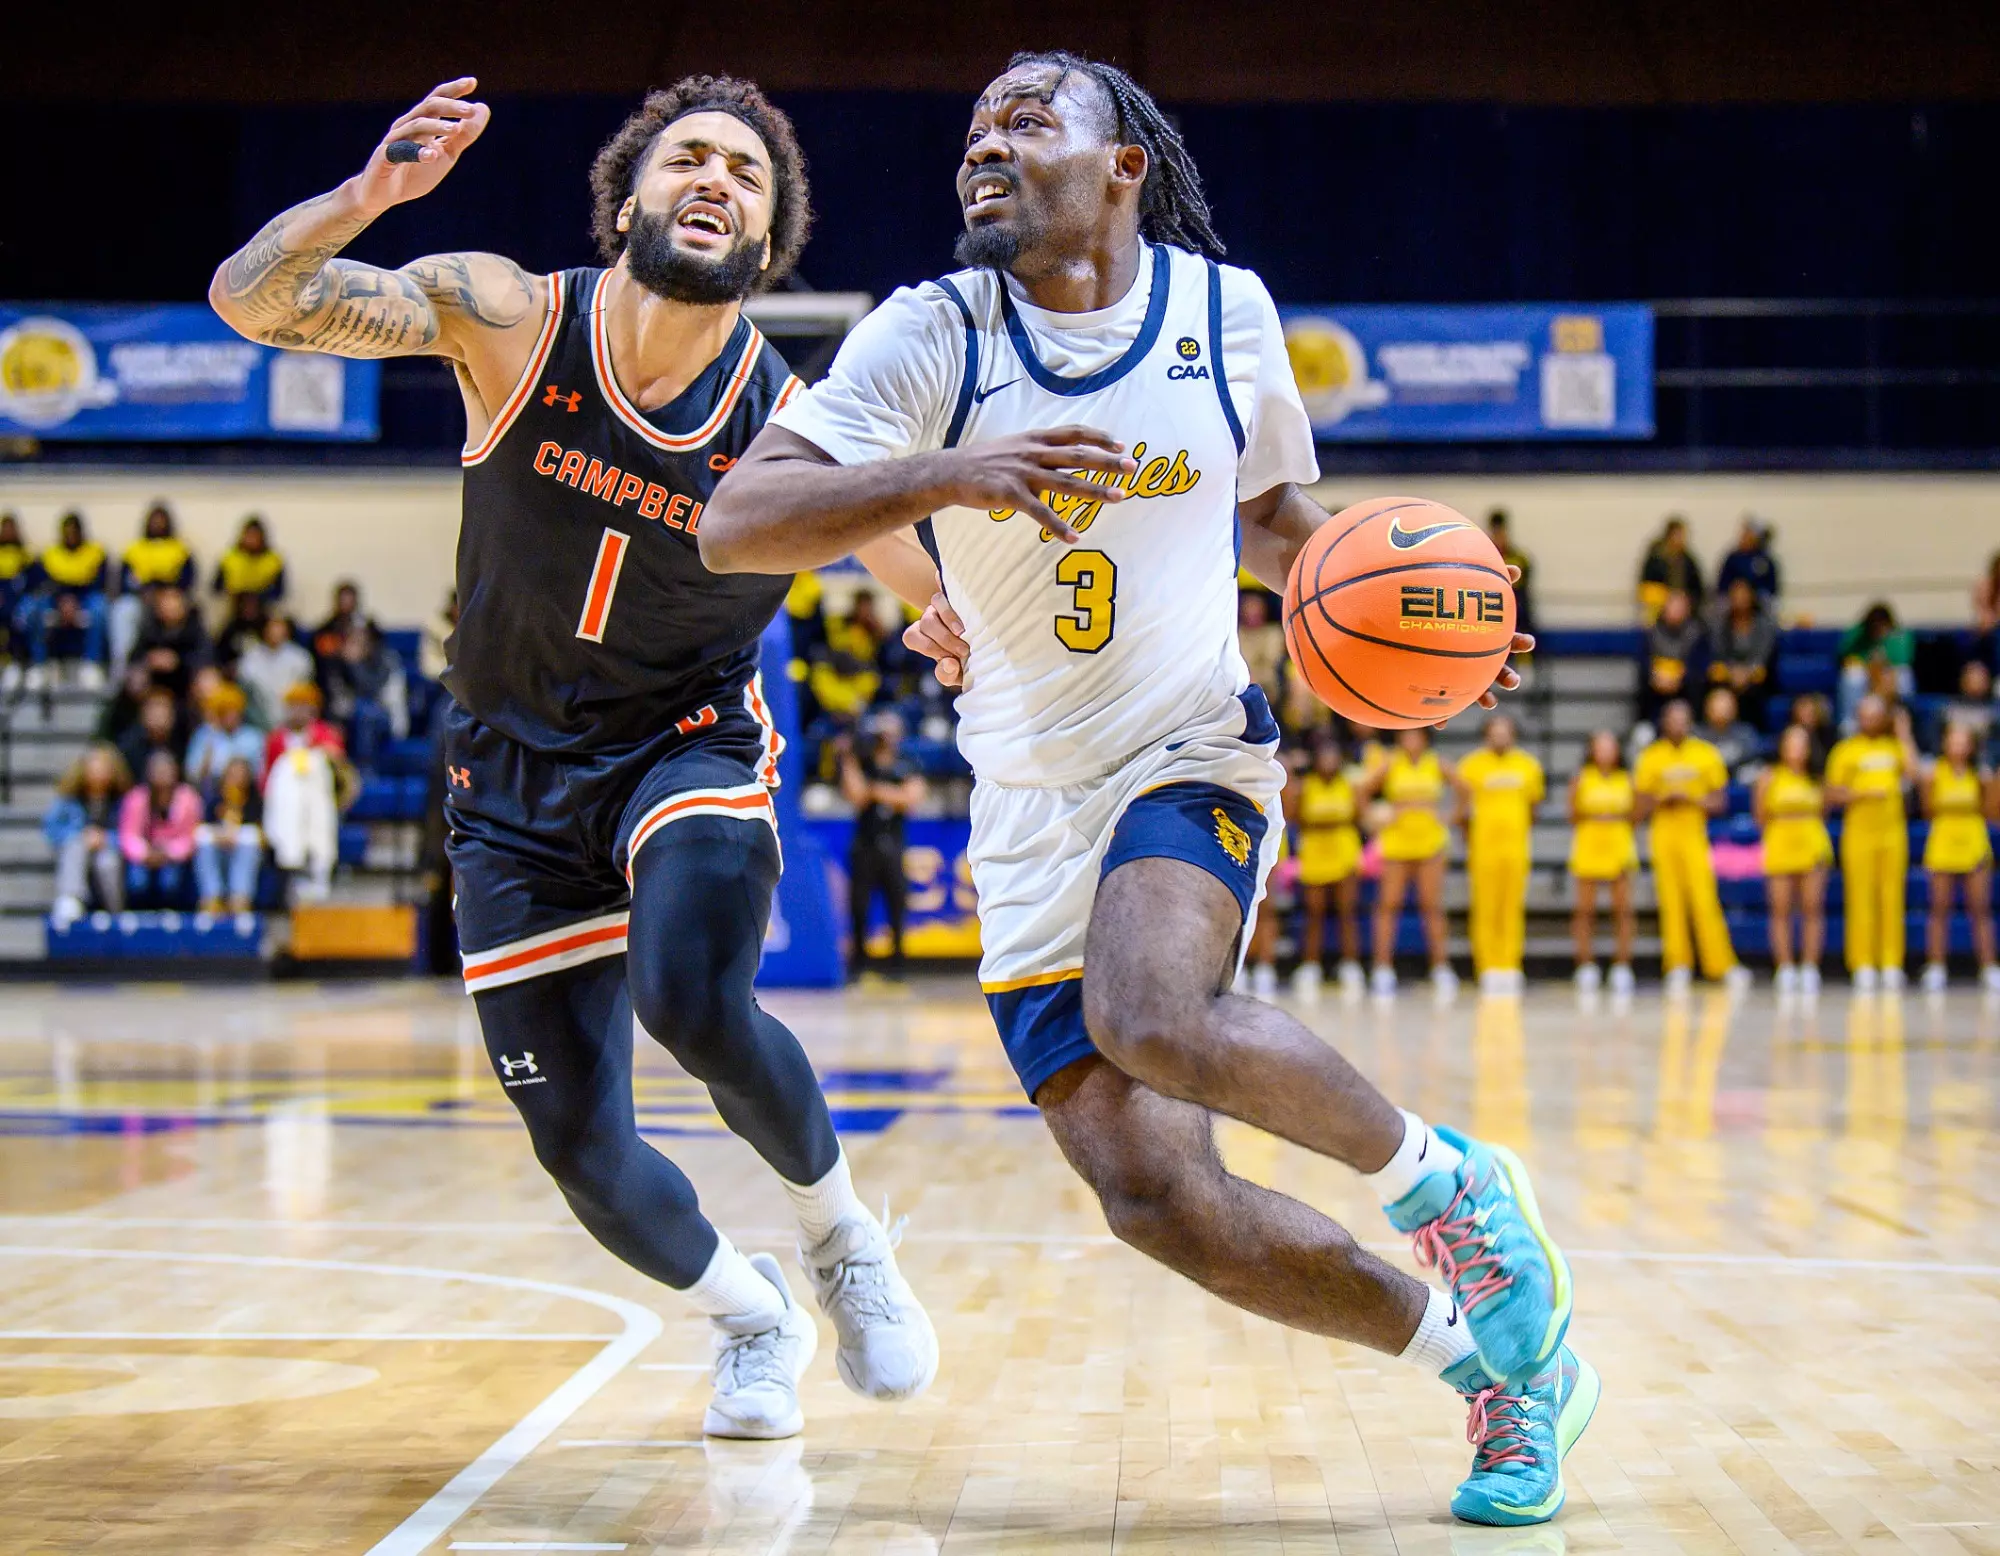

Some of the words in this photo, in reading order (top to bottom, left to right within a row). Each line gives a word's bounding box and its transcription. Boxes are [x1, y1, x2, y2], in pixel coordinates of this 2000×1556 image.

[1180, 341, 1198, 355] 22
[1167, 365, 1210, 380] CAA
[575, 526, 631, 644] 1
[1054, 549, 1117, 654] 3
[1401, 586, 1503, 623] ELITE
